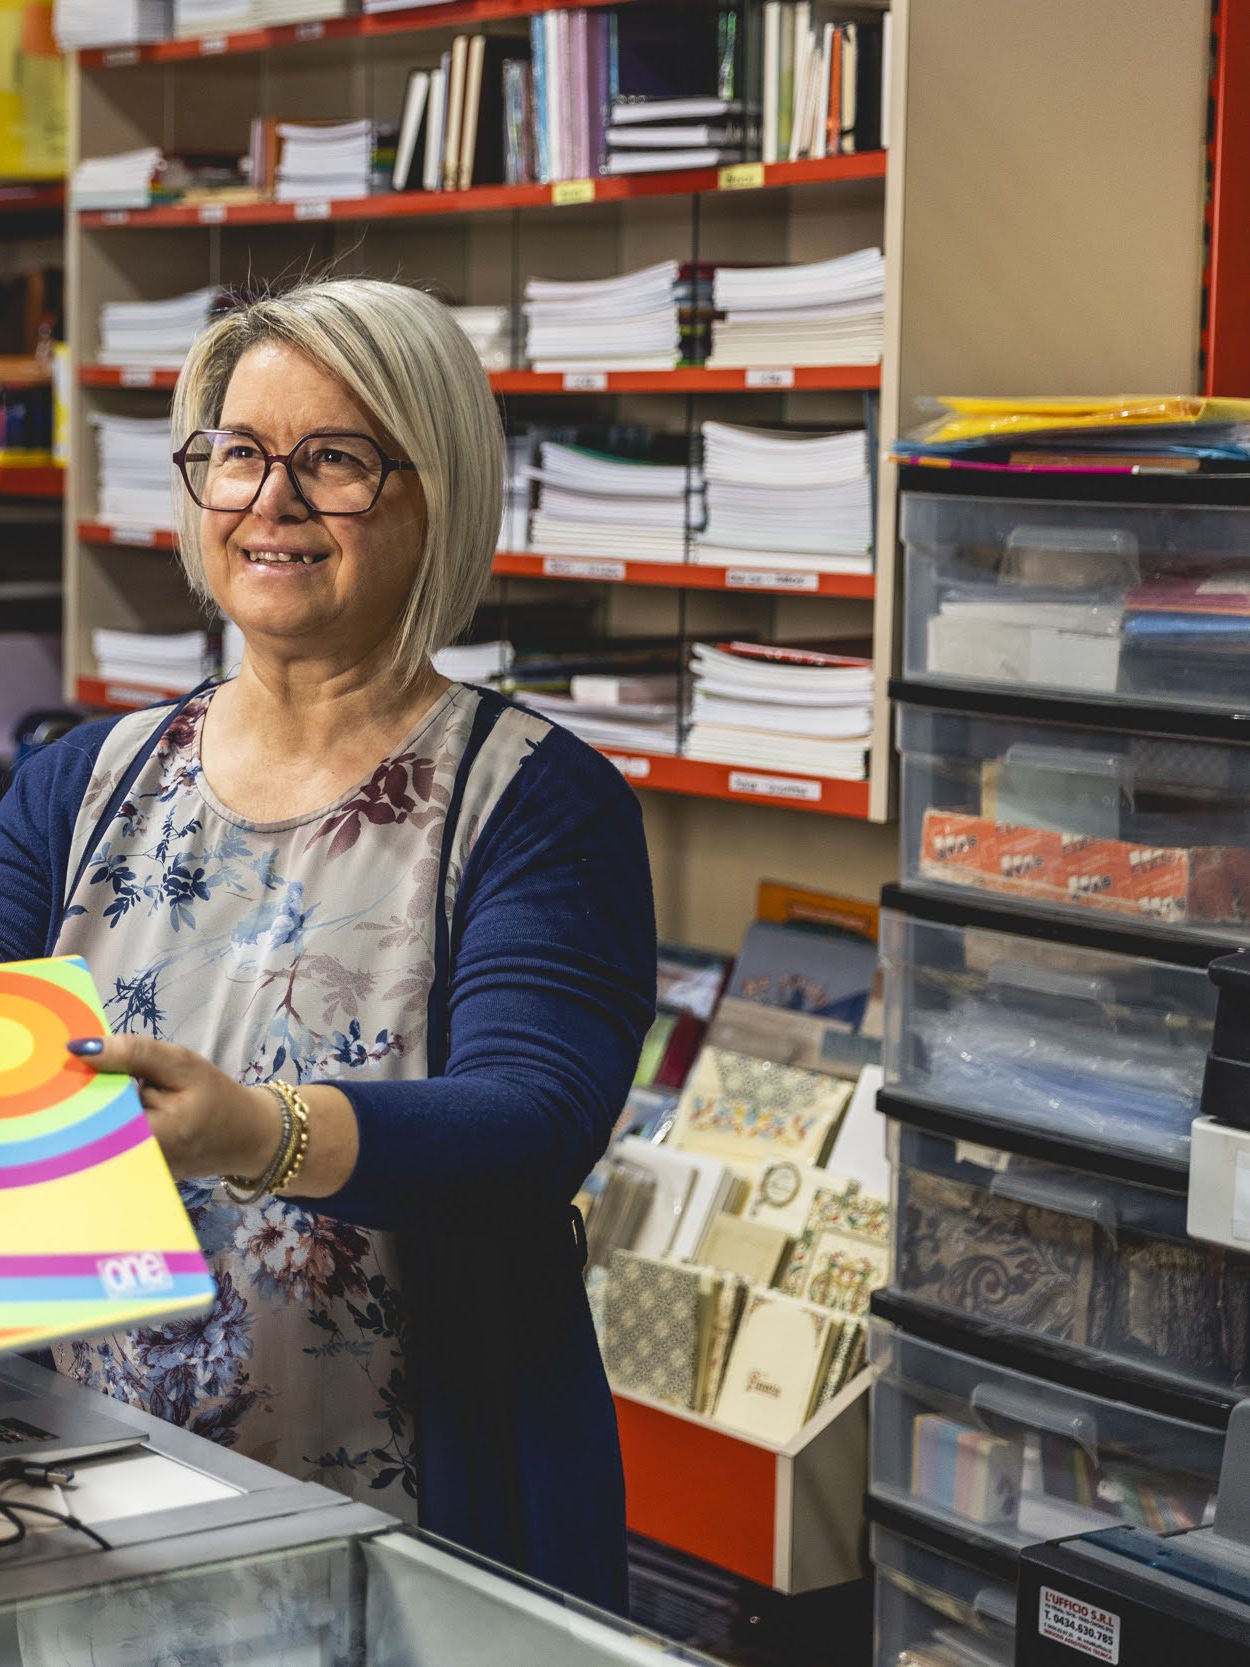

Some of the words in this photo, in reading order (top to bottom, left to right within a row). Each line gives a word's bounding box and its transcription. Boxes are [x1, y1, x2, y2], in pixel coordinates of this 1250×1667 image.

[105, 1252, 162, 1292] one
[1045, 1591, 1088, 1616] L'UFFICIO
[1044, 1610, 1051, 1620] T.
[1053, 1614, 1113, 1645] 0434.630.785
